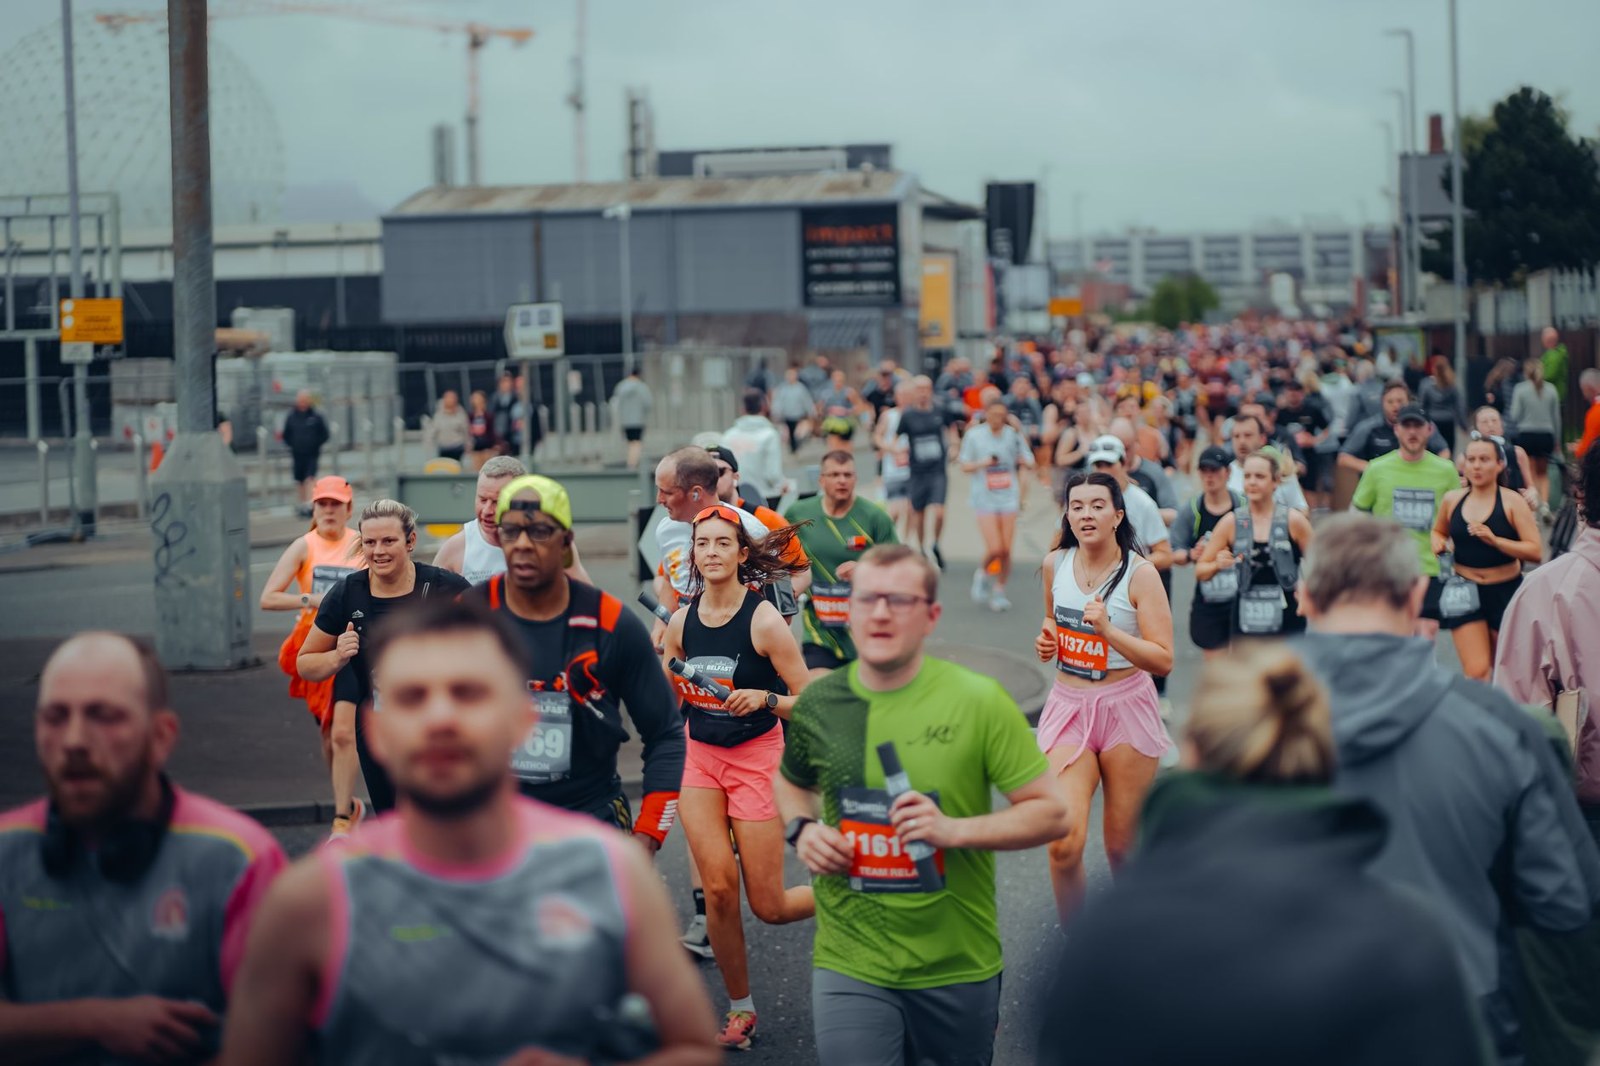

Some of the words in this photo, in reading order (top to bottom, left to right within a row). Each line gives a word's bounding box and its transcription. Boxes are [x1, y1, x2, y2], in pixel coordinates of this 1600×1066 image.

[1059, 633, 1105, 657] 11374A
[1062, 655, 1074, 665] TEAM
[1074, 659, 1095, 669] RELAY
[533, 705, 569, 714] ELFAST
[525, 727, 564, 758] 69
[846, 831, 911, 857] 1161
[859, 866, 887, 877] TEAM
[890, 867, 919, 877] RELA
